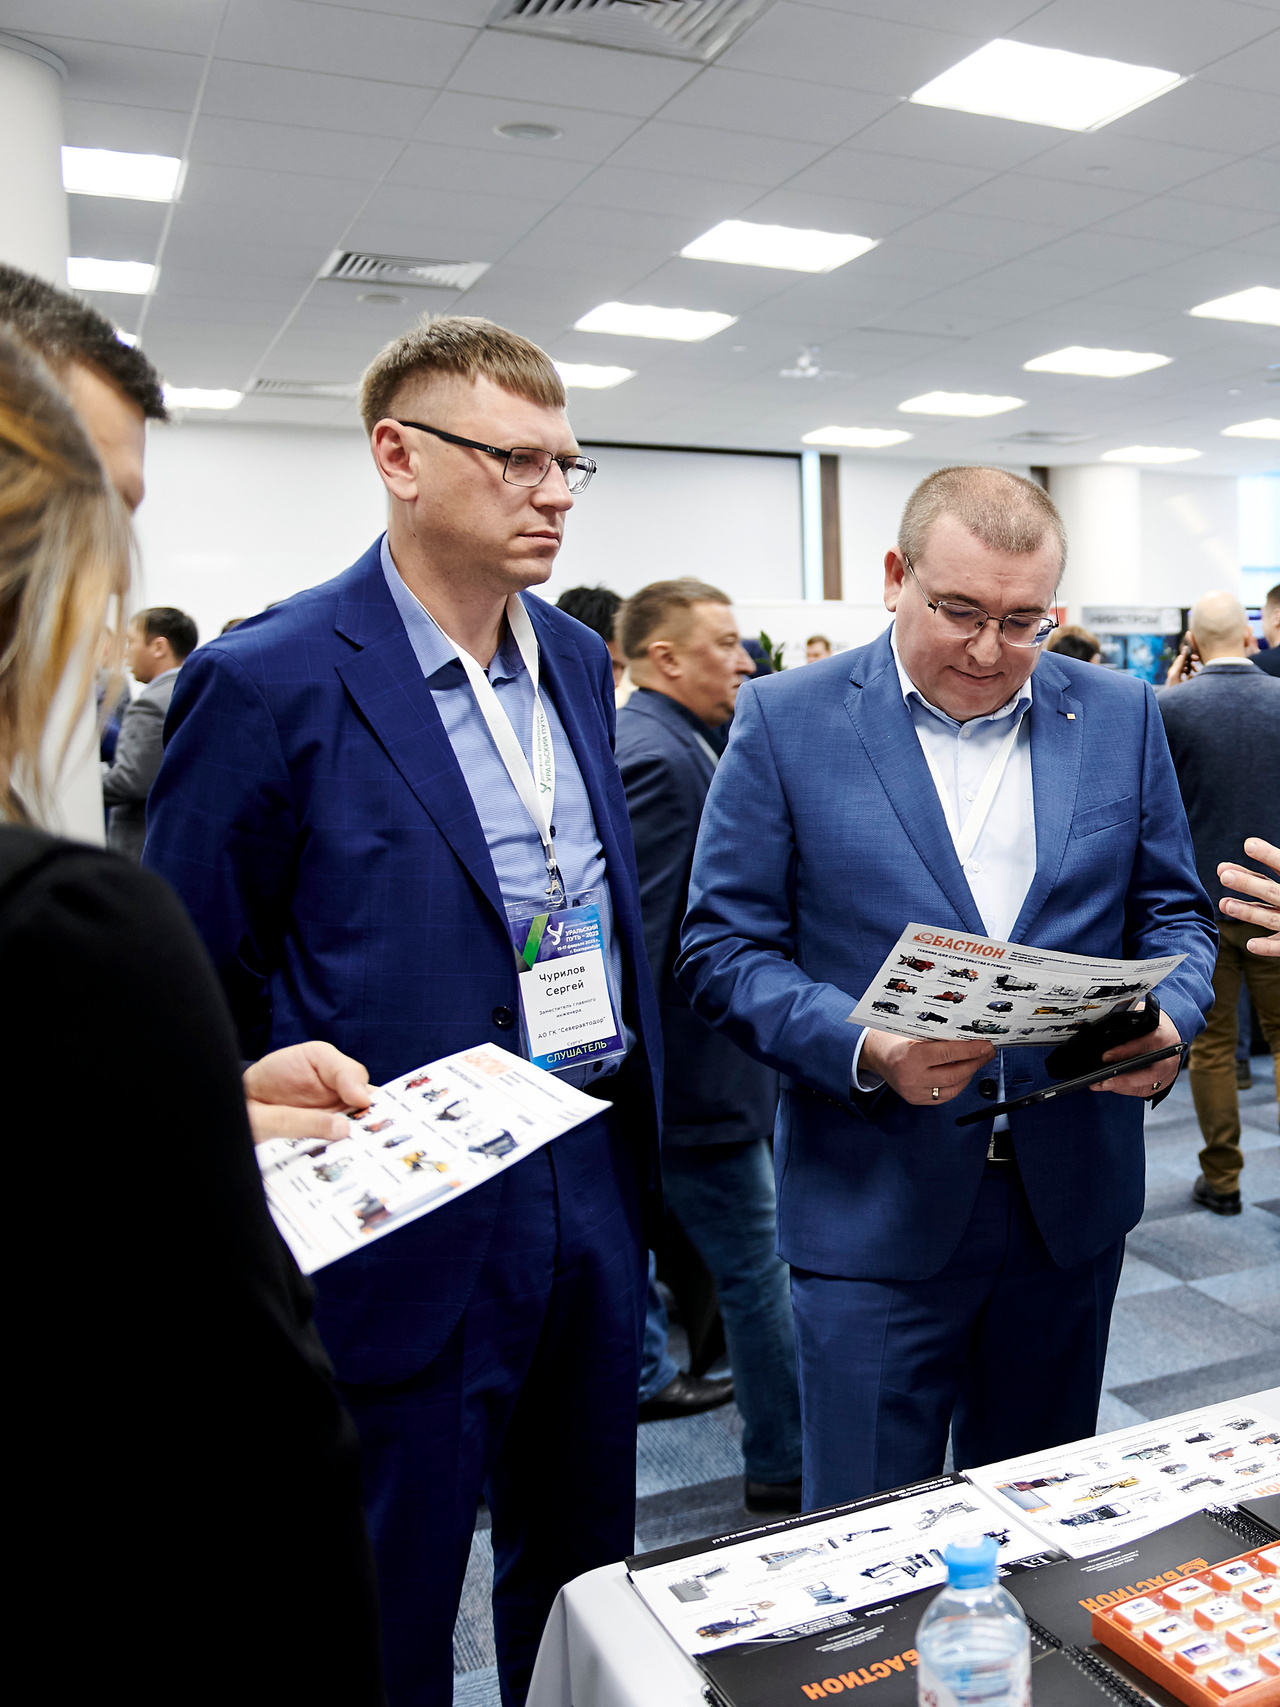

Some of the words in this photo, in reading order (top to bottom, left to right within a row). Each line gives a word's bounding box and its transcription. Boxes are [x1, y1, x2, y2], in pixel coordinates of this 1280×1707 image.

[542, 735, 552, 782] УРАЛЬСКИЙ
[932, 935, 1006, 959] БАСТИОН
[539, 966, 585, 982] Чурилов
[546, 980, 584, 996] Сергей
[547, 1041, 607, 1063] СЛУШАТЕЛЬ
[801, 1649, 919, 1700] БАСТИОН
